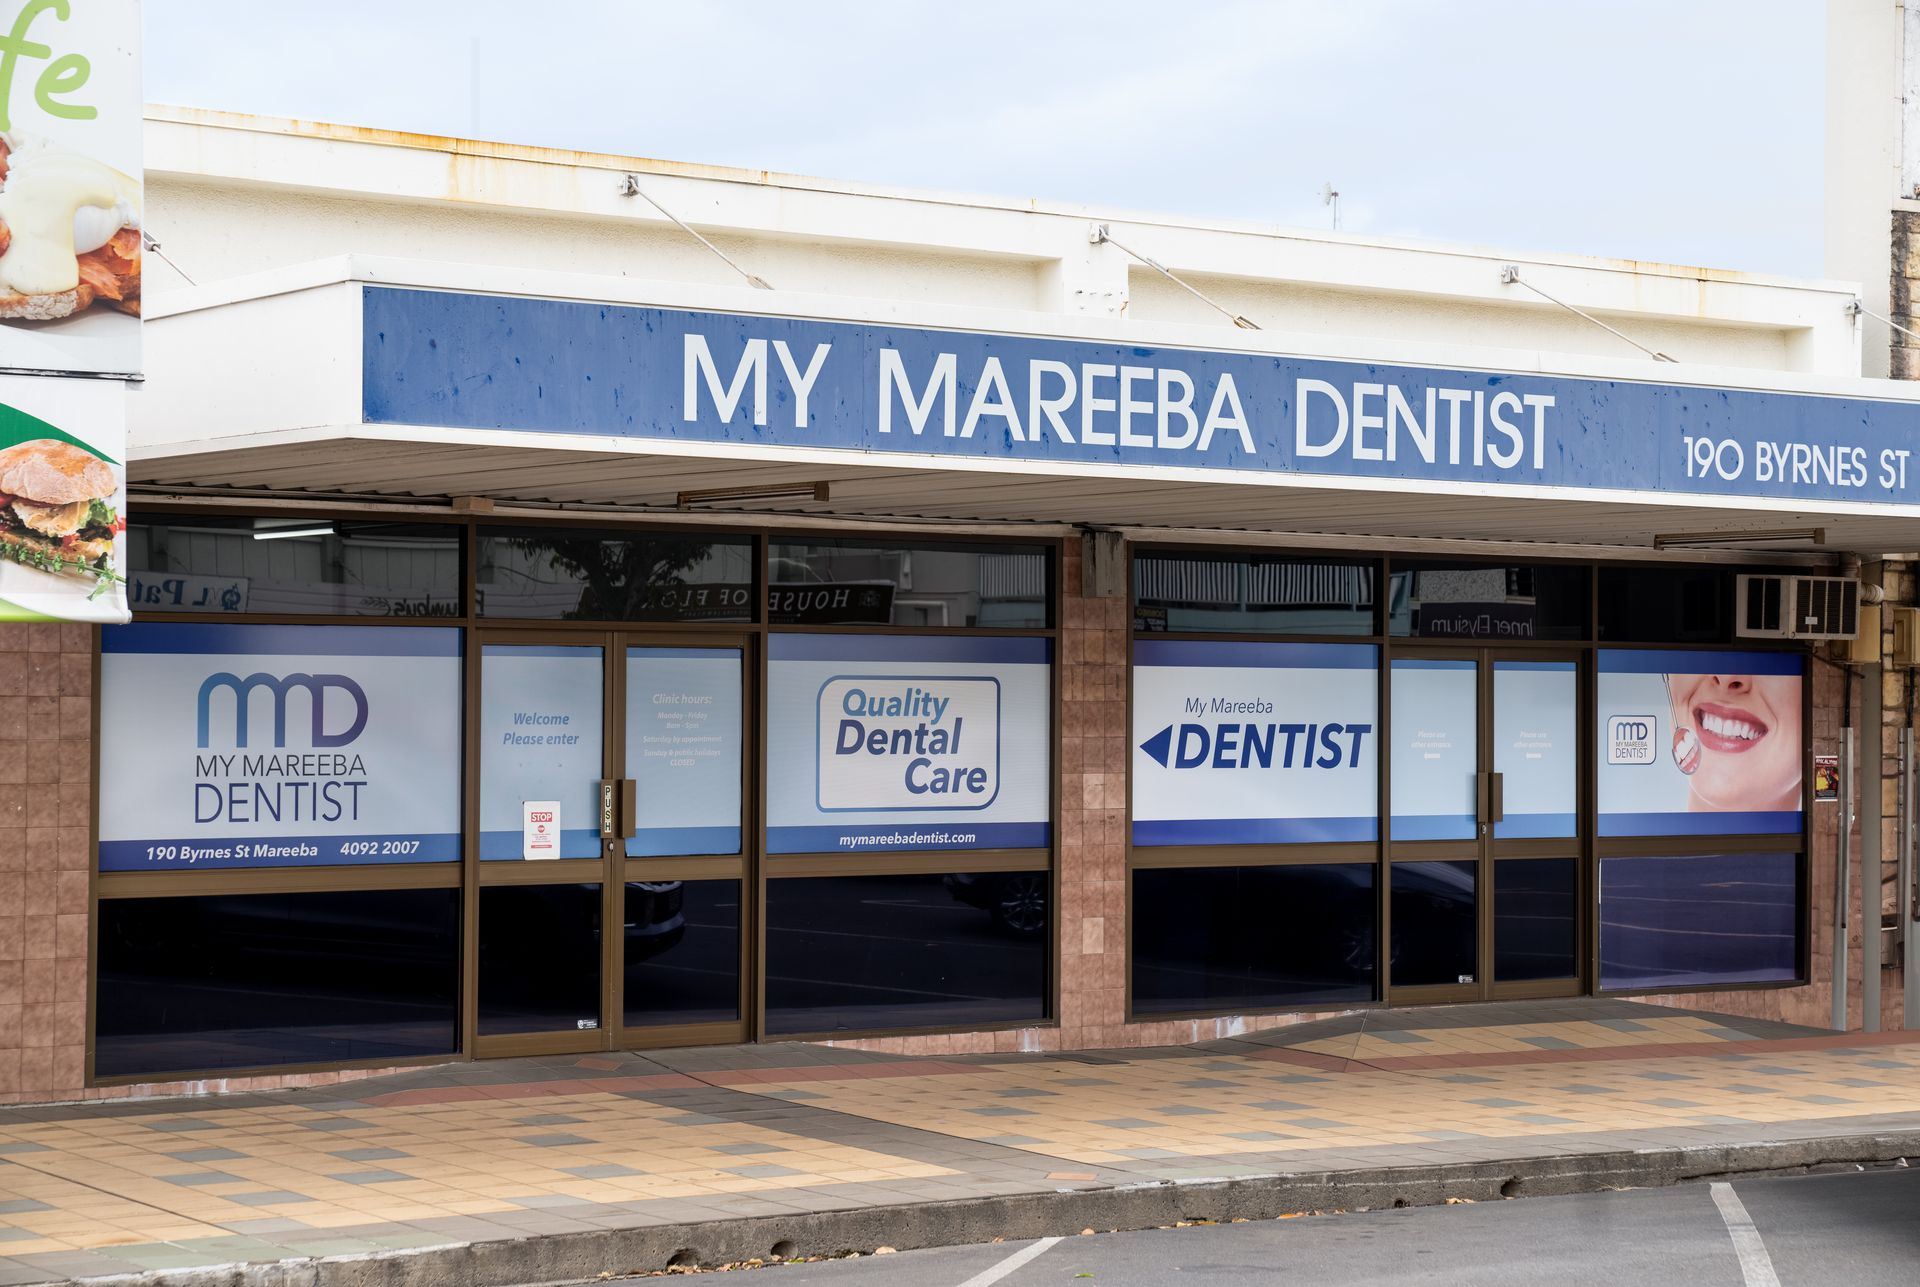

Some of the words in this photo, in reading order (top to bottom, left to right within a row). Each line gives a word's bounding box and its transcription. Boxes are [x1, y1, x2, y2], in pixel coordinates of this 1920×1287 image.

[684, 333, 832, 428] MY
[878, 348, 1257, 454] MAREEBA
[1295, 377, 1556, 470] DENTIST
[1683, 436, 1744, 481] 190
[1756, 441, 1868, 487] BYRNES
[1879, 448, 1910, 489] ST
[652, 693, 680, 704] Clinic
[681, 693, 713, 705] hours:
[842, 687, 950, 725] Quality
[1185, 697, 1207, 718] My
[1210, 697, 1273, 714] Mareeba
[513, 712, 570, 726] Welcome
[502, 733, 544, 745] Please
[546, 734, 580, 745] enter
[835, 717, 963, 756] Dental
[1174, 722, 1372, 769] DENTIST
[1615, 747, 1648, 759] DENTIST
[195, 754, 236, 778] MY
[243, 754, 367, 777] MAREEBA
[904, 757, 988, 795] Care
[194, 780, 368, 824] DENTIST
[531, 812, 552, 822] STOP
[839, 831, 976, 848] mymareebadentist.com
[146, 846, 176, 861] 190
[180, 845, 231, 863] Byrnes
[234, 844, 250, 859] St
[253, 842, 318, 858] Mareeba
[339, 842, 378, 856] 4092
[382, 841, 420, 855] 2007
